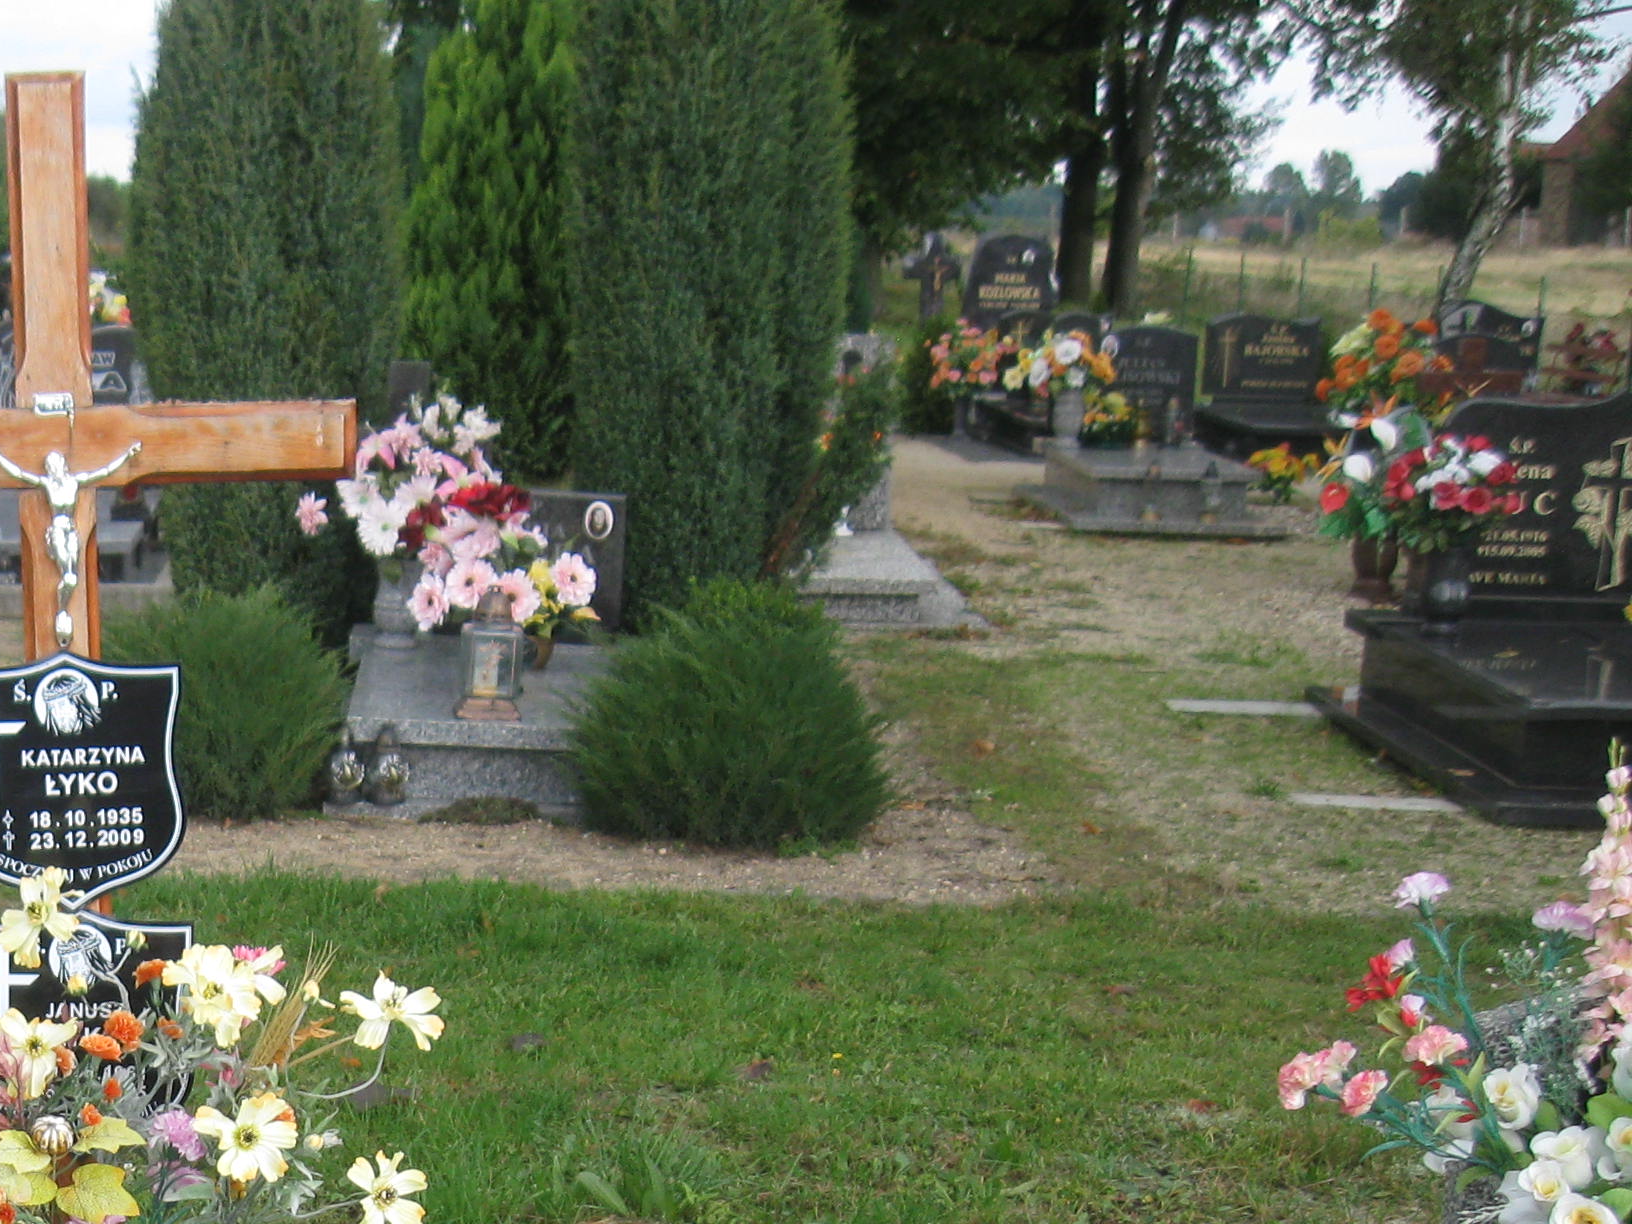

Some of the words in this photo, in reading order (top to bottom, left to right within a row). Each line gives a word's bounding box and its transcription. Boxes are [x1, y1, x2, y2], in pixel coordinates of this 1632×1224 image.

[13, 678, 32, 702] Ś.
[101, 682, 118, 700] P.
[20, 746, 146, 768] KATARZYNA
[44, 770, 119, 796] ŁYKO
[79, 866, 94, 881] W
[97, 849, 154, 878] POKOJU
